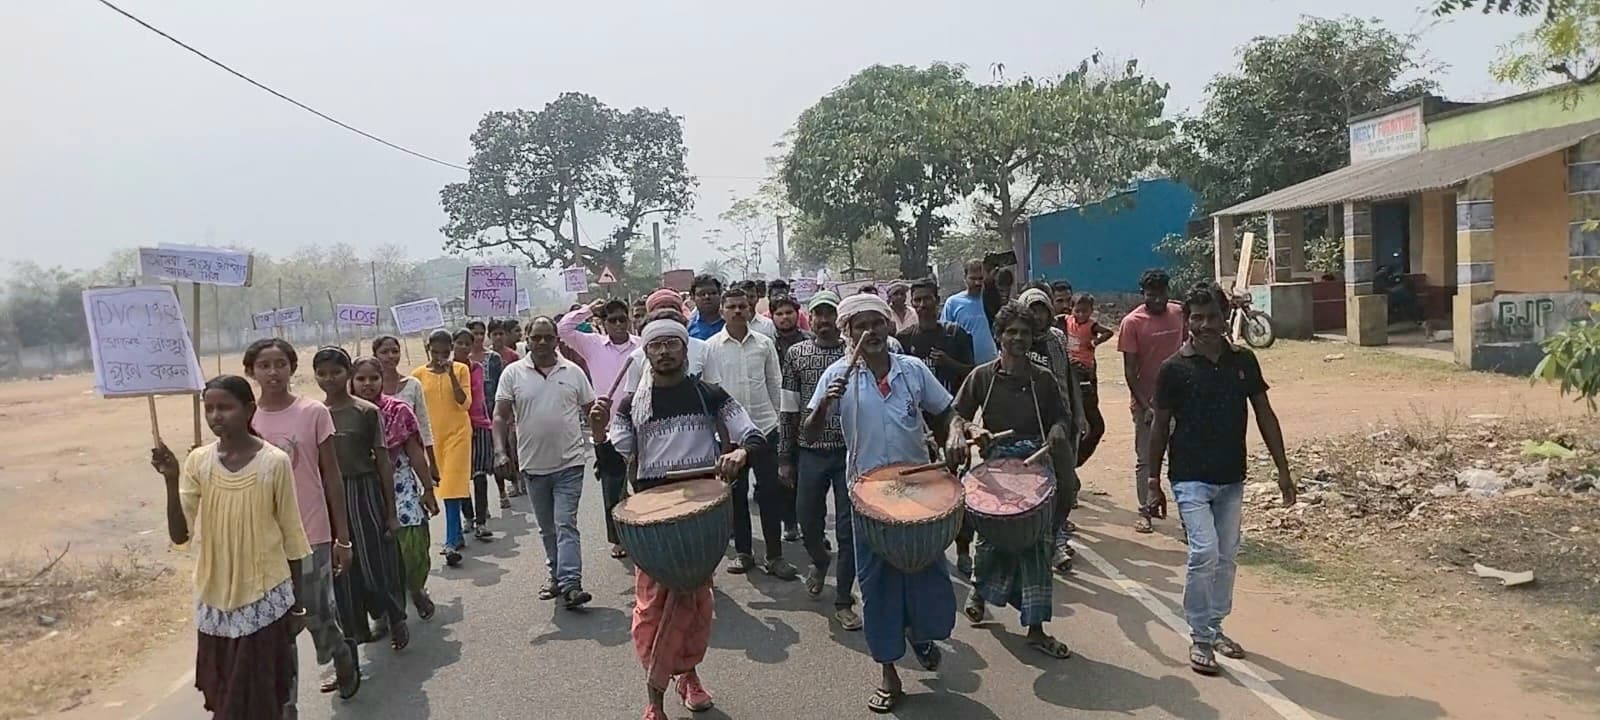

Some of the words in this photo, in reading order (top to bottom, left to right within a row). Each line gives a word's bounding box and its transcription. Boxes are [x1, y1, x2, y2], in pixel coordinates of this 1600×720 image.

[96, 299, 137, 328] DVC
[338, 308, 377, 325] CLOSE
[1498, 298, 1555, 327] BJP
